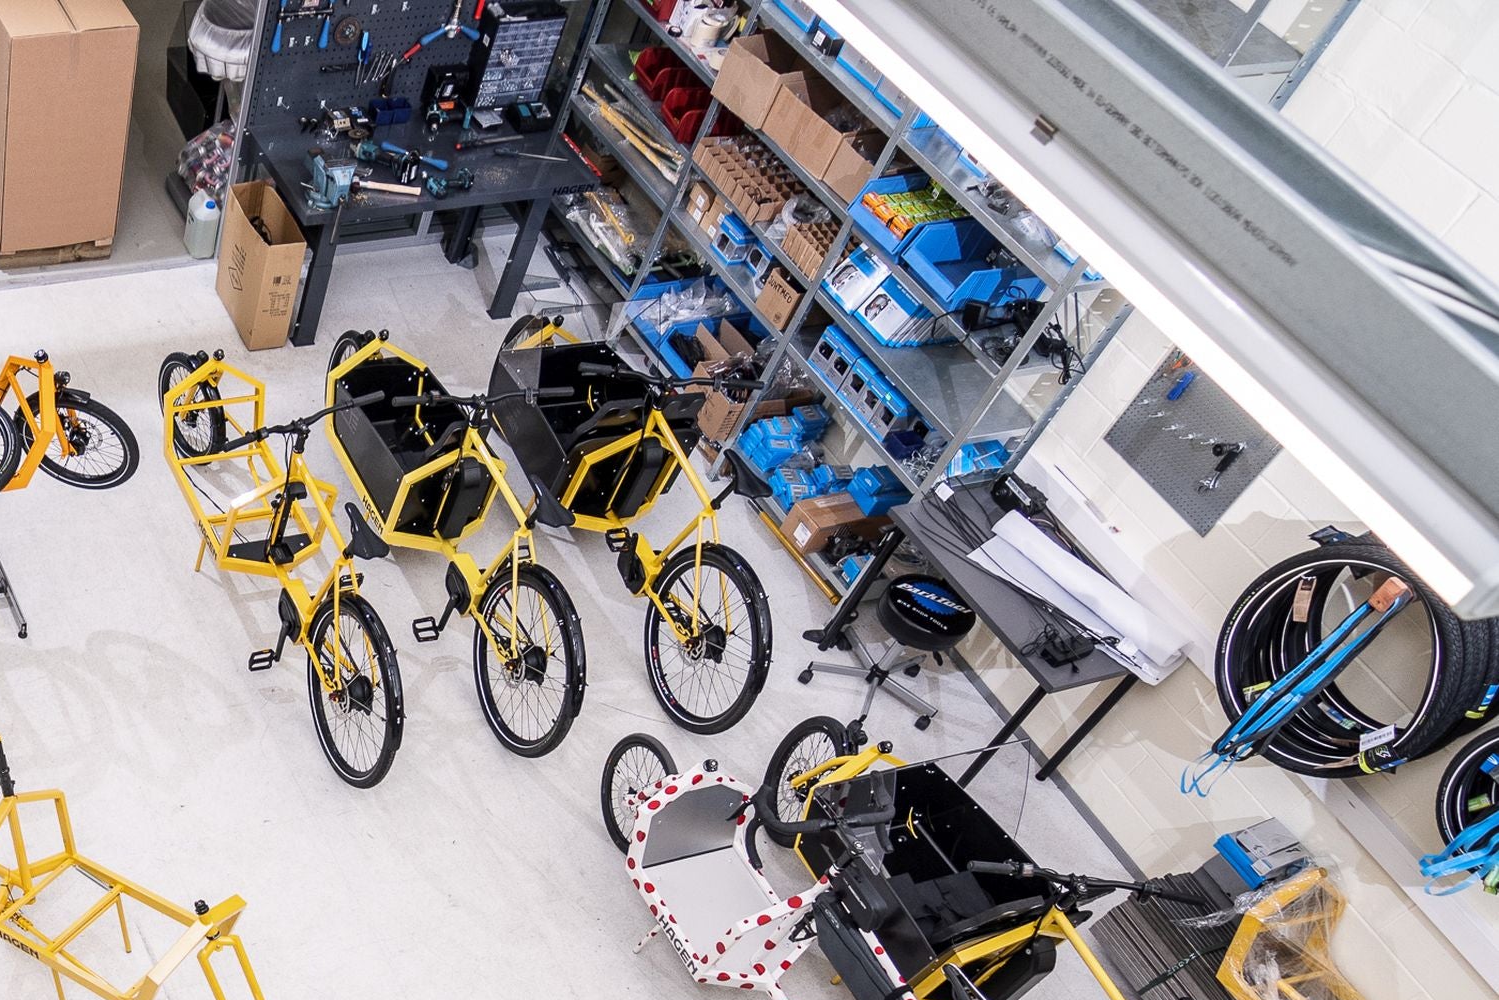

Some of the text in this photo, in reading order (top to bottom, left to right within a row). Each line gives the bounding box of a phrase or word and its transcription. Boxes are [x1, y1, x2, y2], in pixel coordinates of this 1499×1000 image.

[551, 183, 595, 197] HAGEN
[362, 495, 384, 536] HAGEN
[658, 914, 699, 976] HAGEN
